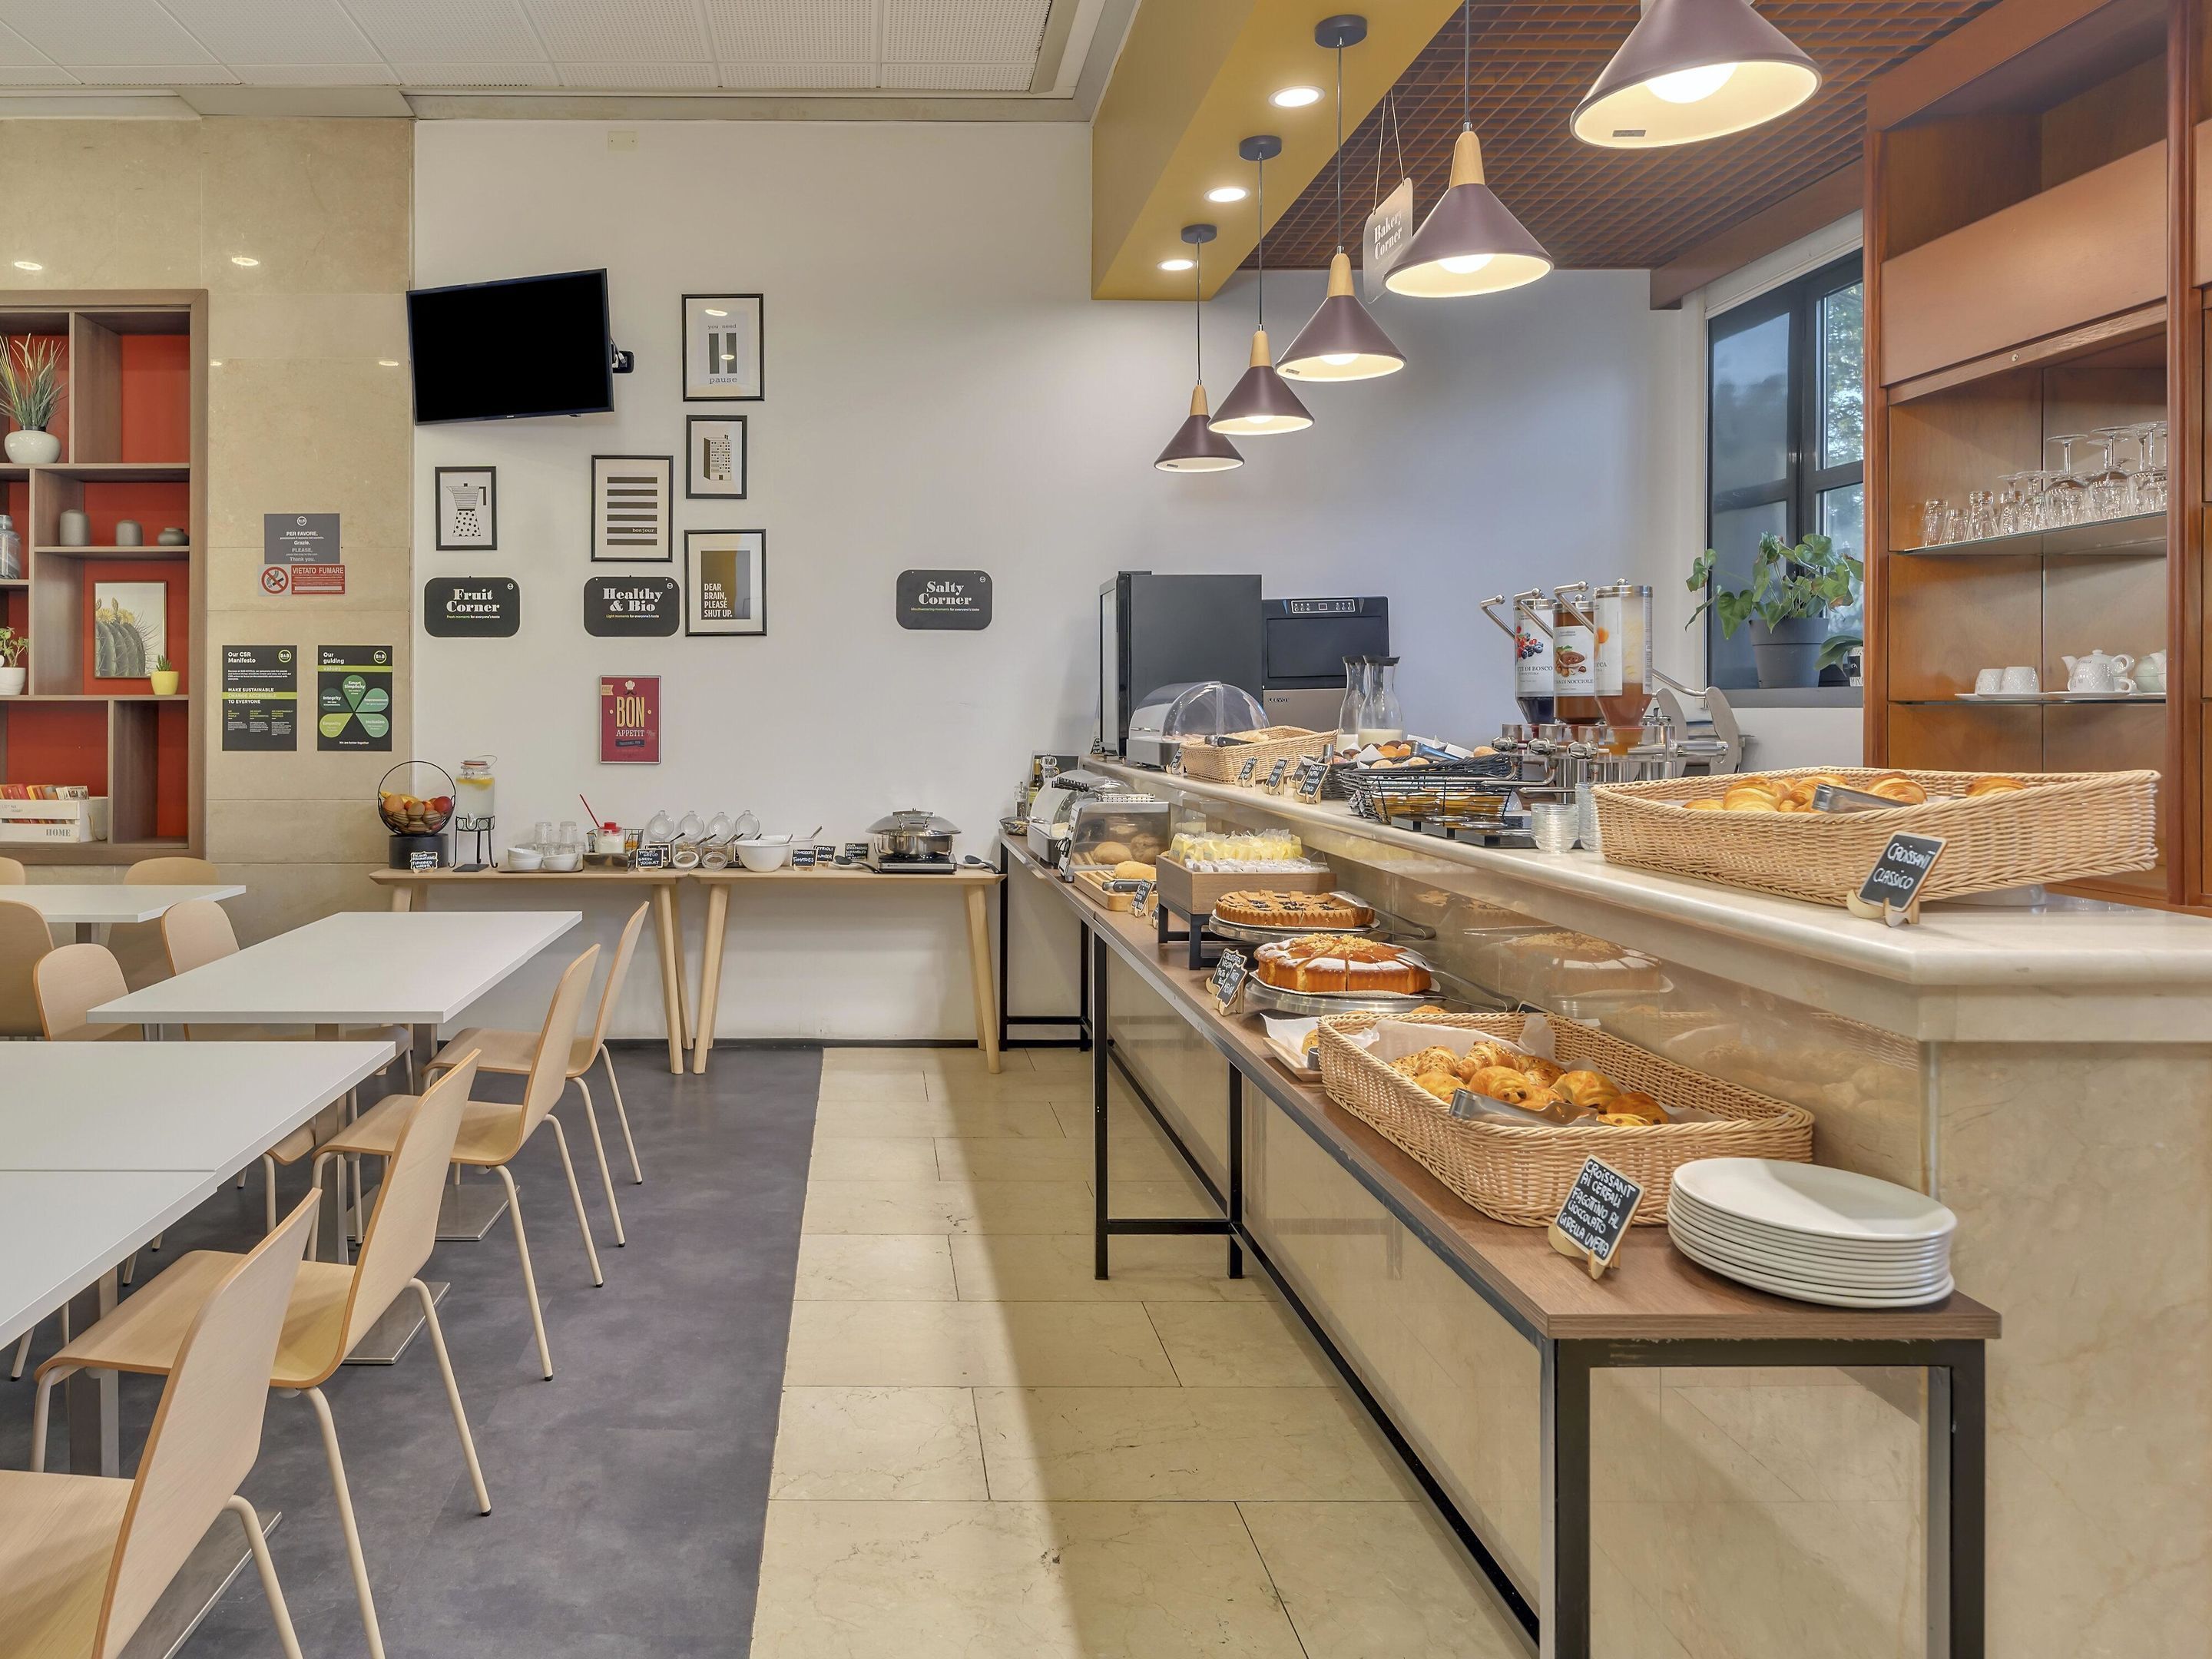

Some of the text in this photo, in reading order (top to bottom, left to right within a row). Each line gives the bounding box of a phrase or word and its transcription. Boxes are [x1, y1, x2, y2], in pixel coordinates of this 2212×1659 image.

[1375, 227, 1402, 260] Corner
[453, 588, 493, 600] Fruit
[603, 588, 663, 603] Healthy
[926, 581, 964, 596] Salty
[704, 592, 727, 601] BRAIN,
[918, 593, 972, 604] Corner
[446, 600, 500, 612] Corner
[609, 600, 656, 611] & Bio
[704, 609, 733, 618] SHUT UP.
[616, 696, 645, 727] BON
[46, 829, 71, 837] HOME
[1873, 868, 1915, 889] CLASSICO
[1585, 1161, 1636, 1197] CROISSANT
[1591, 1181, 1623, 1209] CEREALI
[1571, 1187, 1621, 1230] FAGOTTINO AL
[1559, 1212, 1585, 1240] GIRELLA
